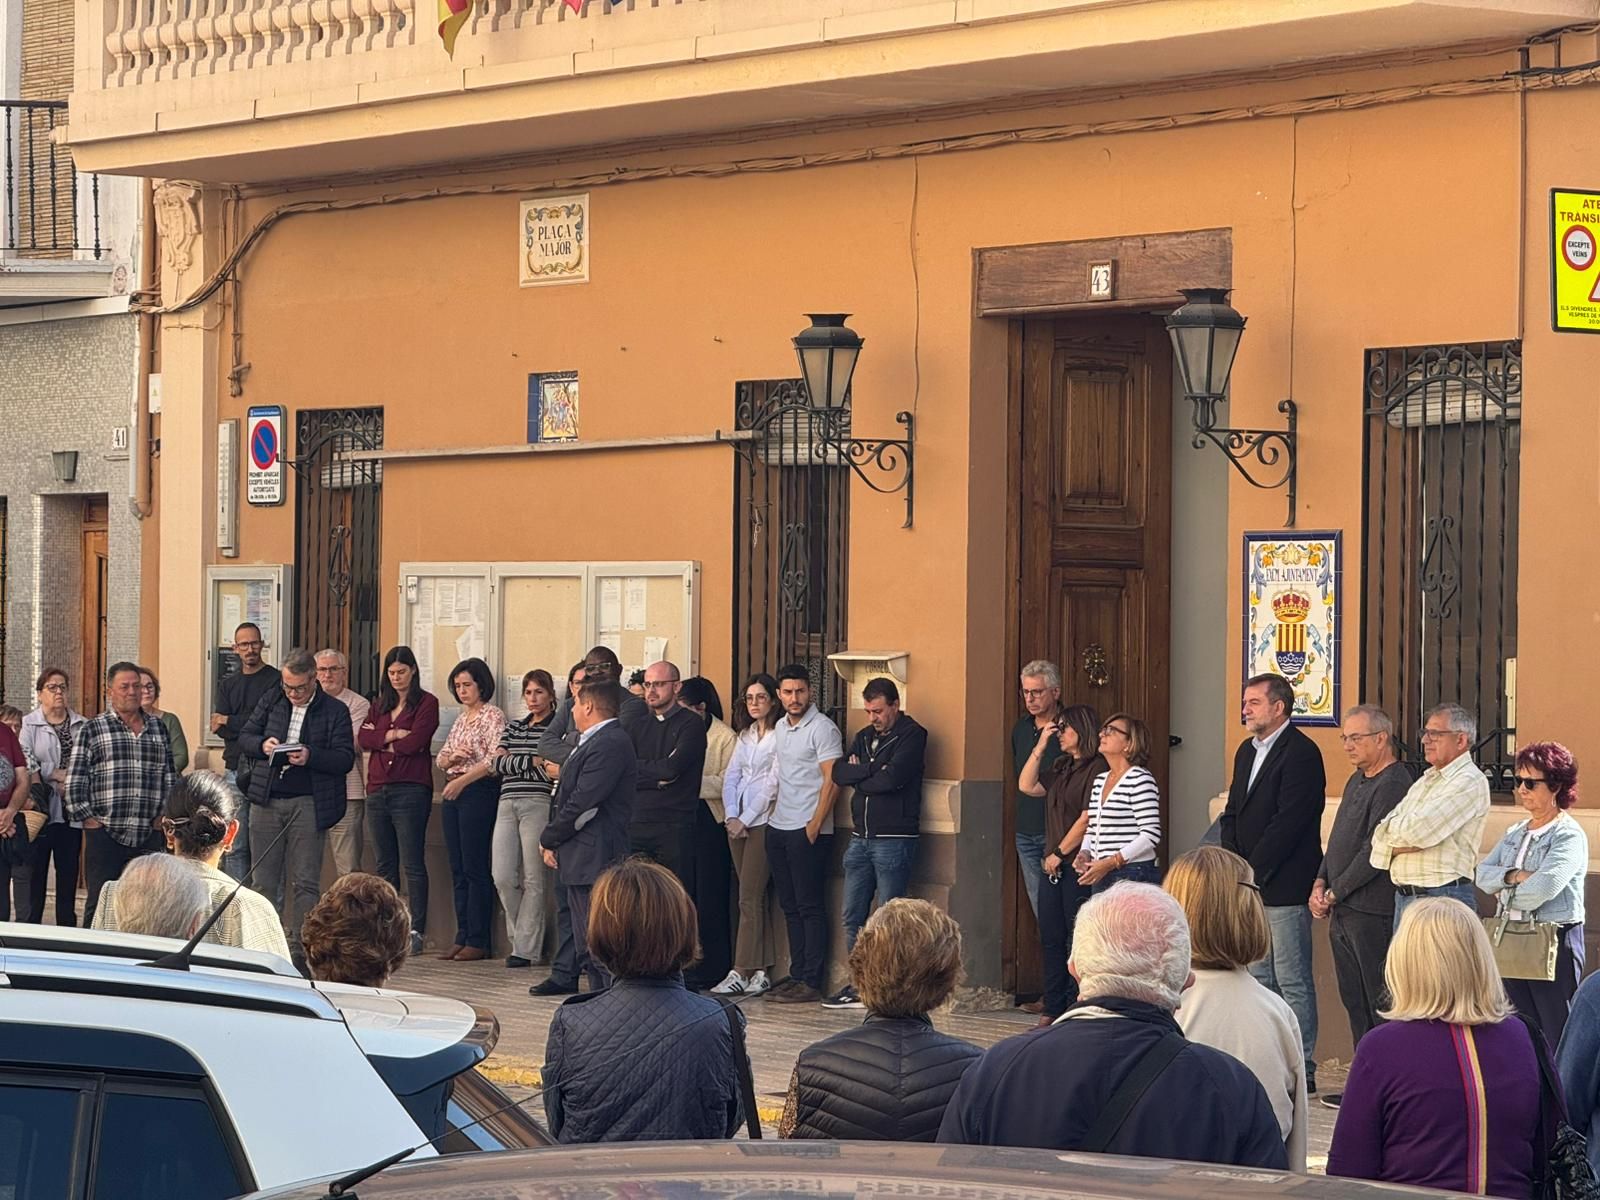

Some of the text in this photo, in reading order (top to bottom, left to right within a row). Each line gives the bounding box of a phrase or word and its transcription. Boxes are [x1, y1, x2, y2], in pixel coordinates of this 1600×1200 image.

[538, 224, 571, 241] PLAÇA
[539, 241, 571, 256] MAJOR
[1092, 269, 1110, 292] 43
[114, 429, 125, 447] 41
